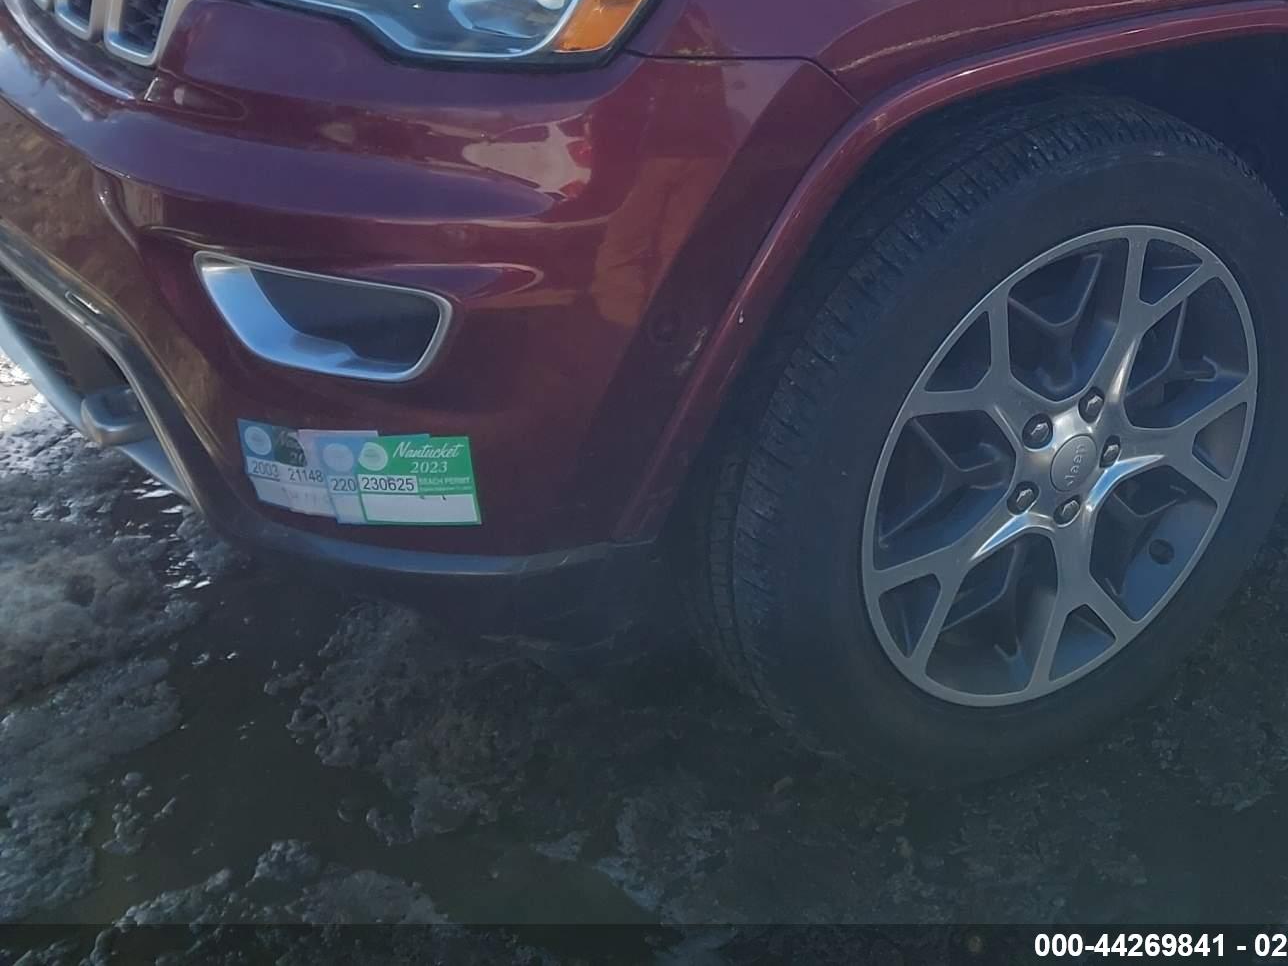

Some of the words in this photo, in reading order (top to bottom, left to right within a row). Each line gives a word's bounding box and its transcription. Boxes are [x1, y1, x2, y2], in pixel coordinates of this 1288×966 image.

[393, 441, 465, 459] Nantucket
[410, 460, 449, 474] 2023
[362, 476, 415, 491] 230625
